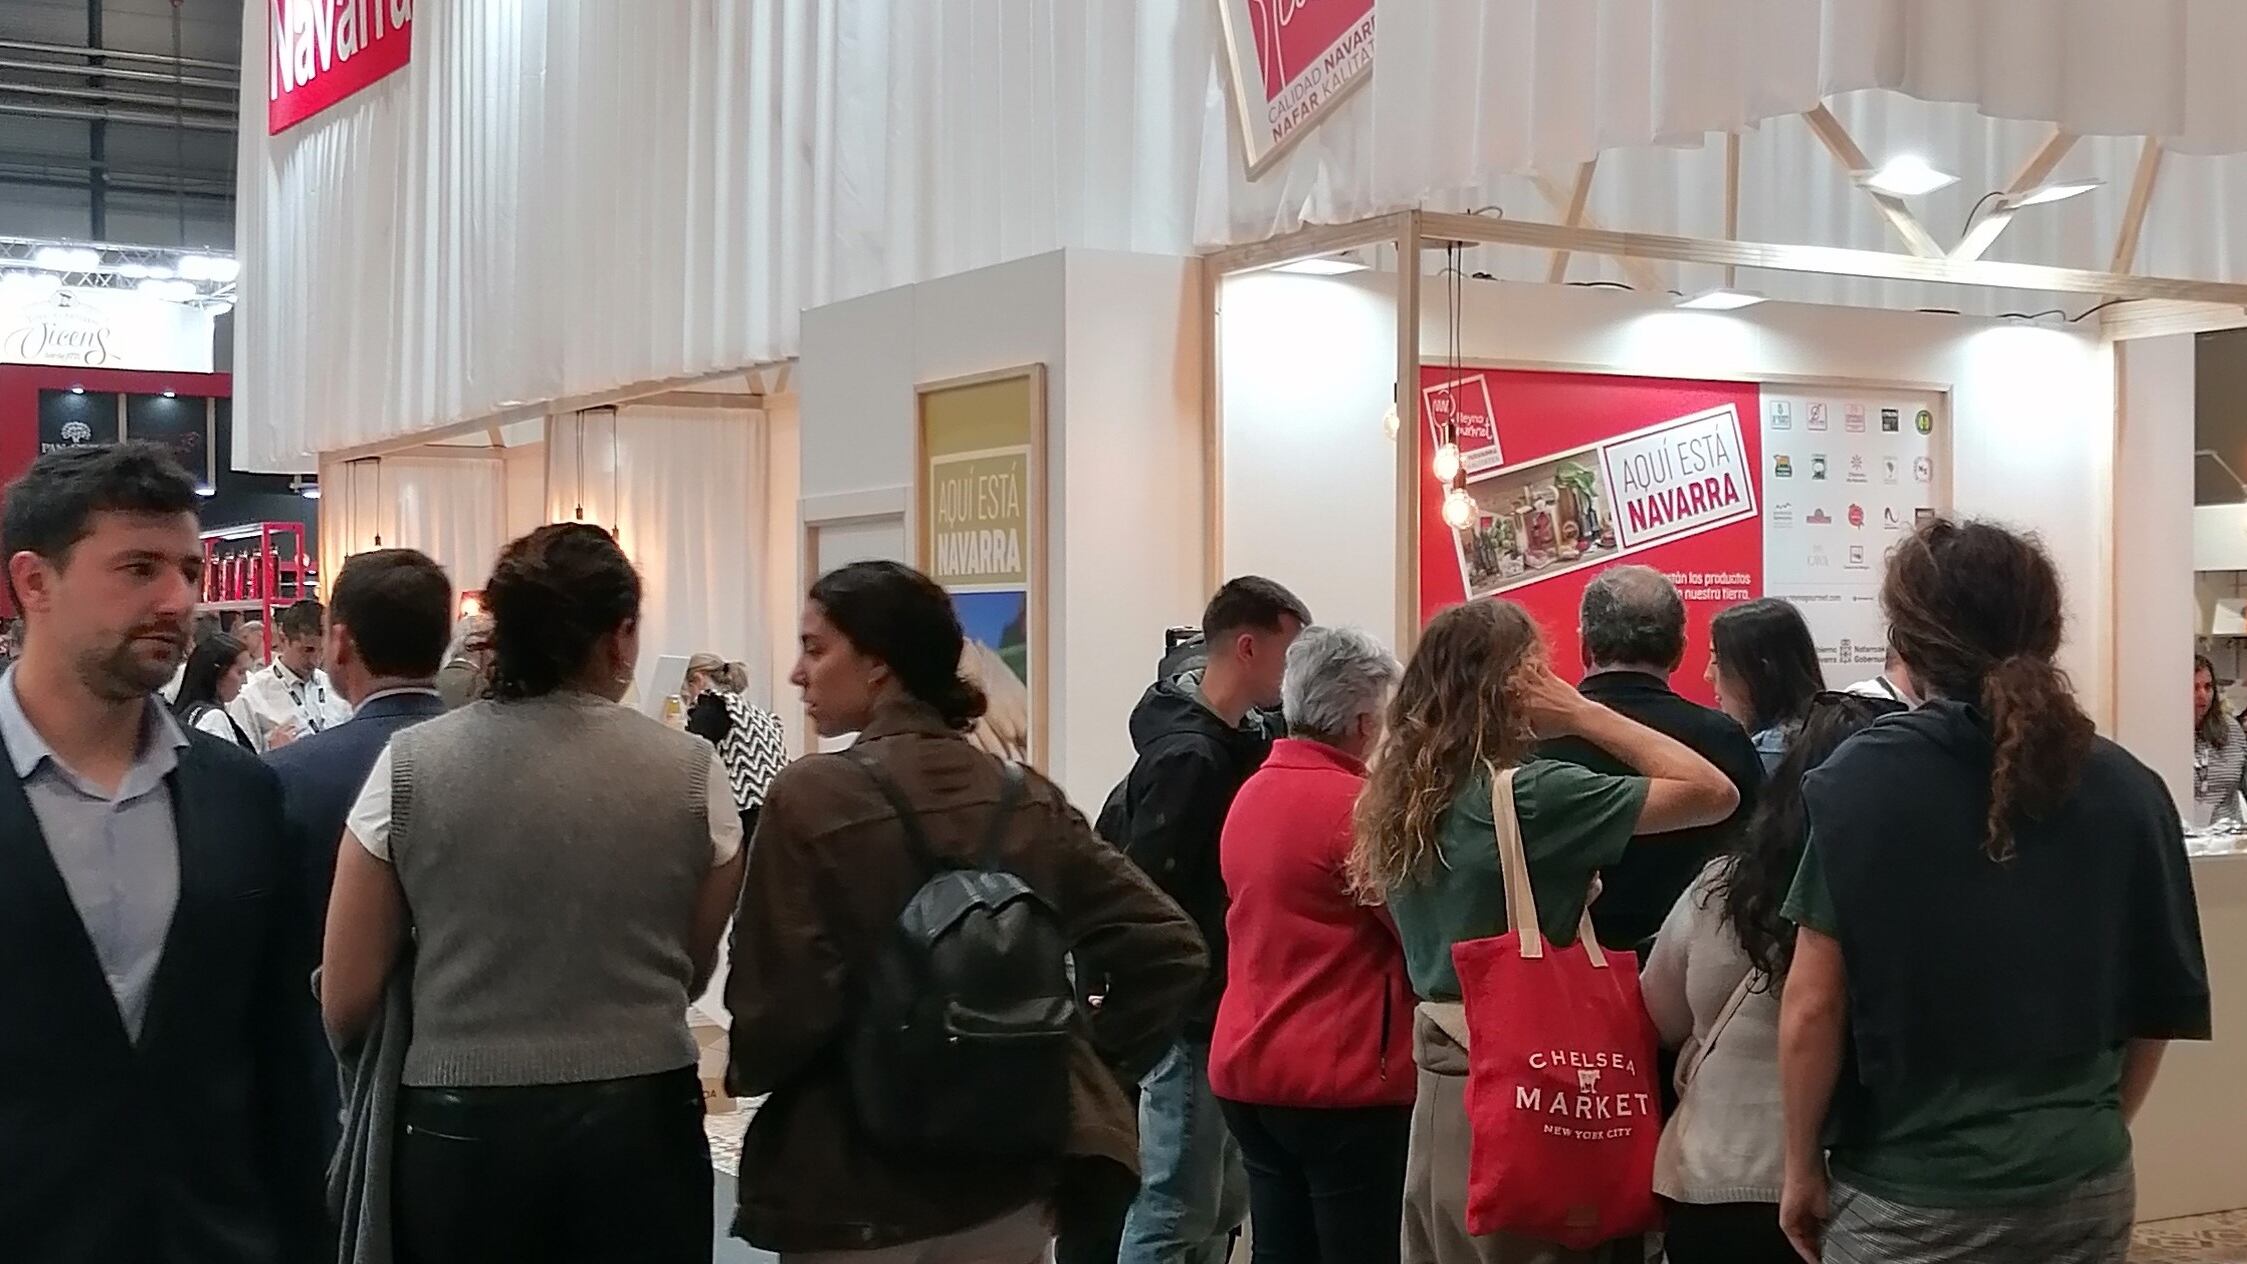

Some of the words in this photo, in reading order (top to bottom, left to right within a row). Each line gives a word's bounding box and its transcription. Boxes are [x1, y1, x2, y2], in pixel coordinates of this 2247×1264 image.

[1268, 68, 1322, 124] CALIDAD
[1272, 92, 1320, 143] NAFAR
[1623, 436, 1675, 495] AQUÍ
[1679, 424, 1731, 477] ESTÁ
[938, 465, 975, 529] AQUÍ
[978, 461, 1020, 521] ESTÁ
[1626, 473, 1740, 534] NAVARRA
[937, 527, 1021, 577] NAVARRA
[1664, 571, 1687, 584] stán
[1689, 572, 1703, 584] los
[1704, 572, 1751, 587] productos
[1684, 588, 1721, 600] nuestra
[1529, 1050, 1636, 1076] CHELSEA
[1515, 1086, 1649, 1120] MARKET
[1543, 1124, 1572, 1137] NEW
[1575, 1130, 1604, 1140] YORK
[1606, 1127, 1633, 1139] CITY
